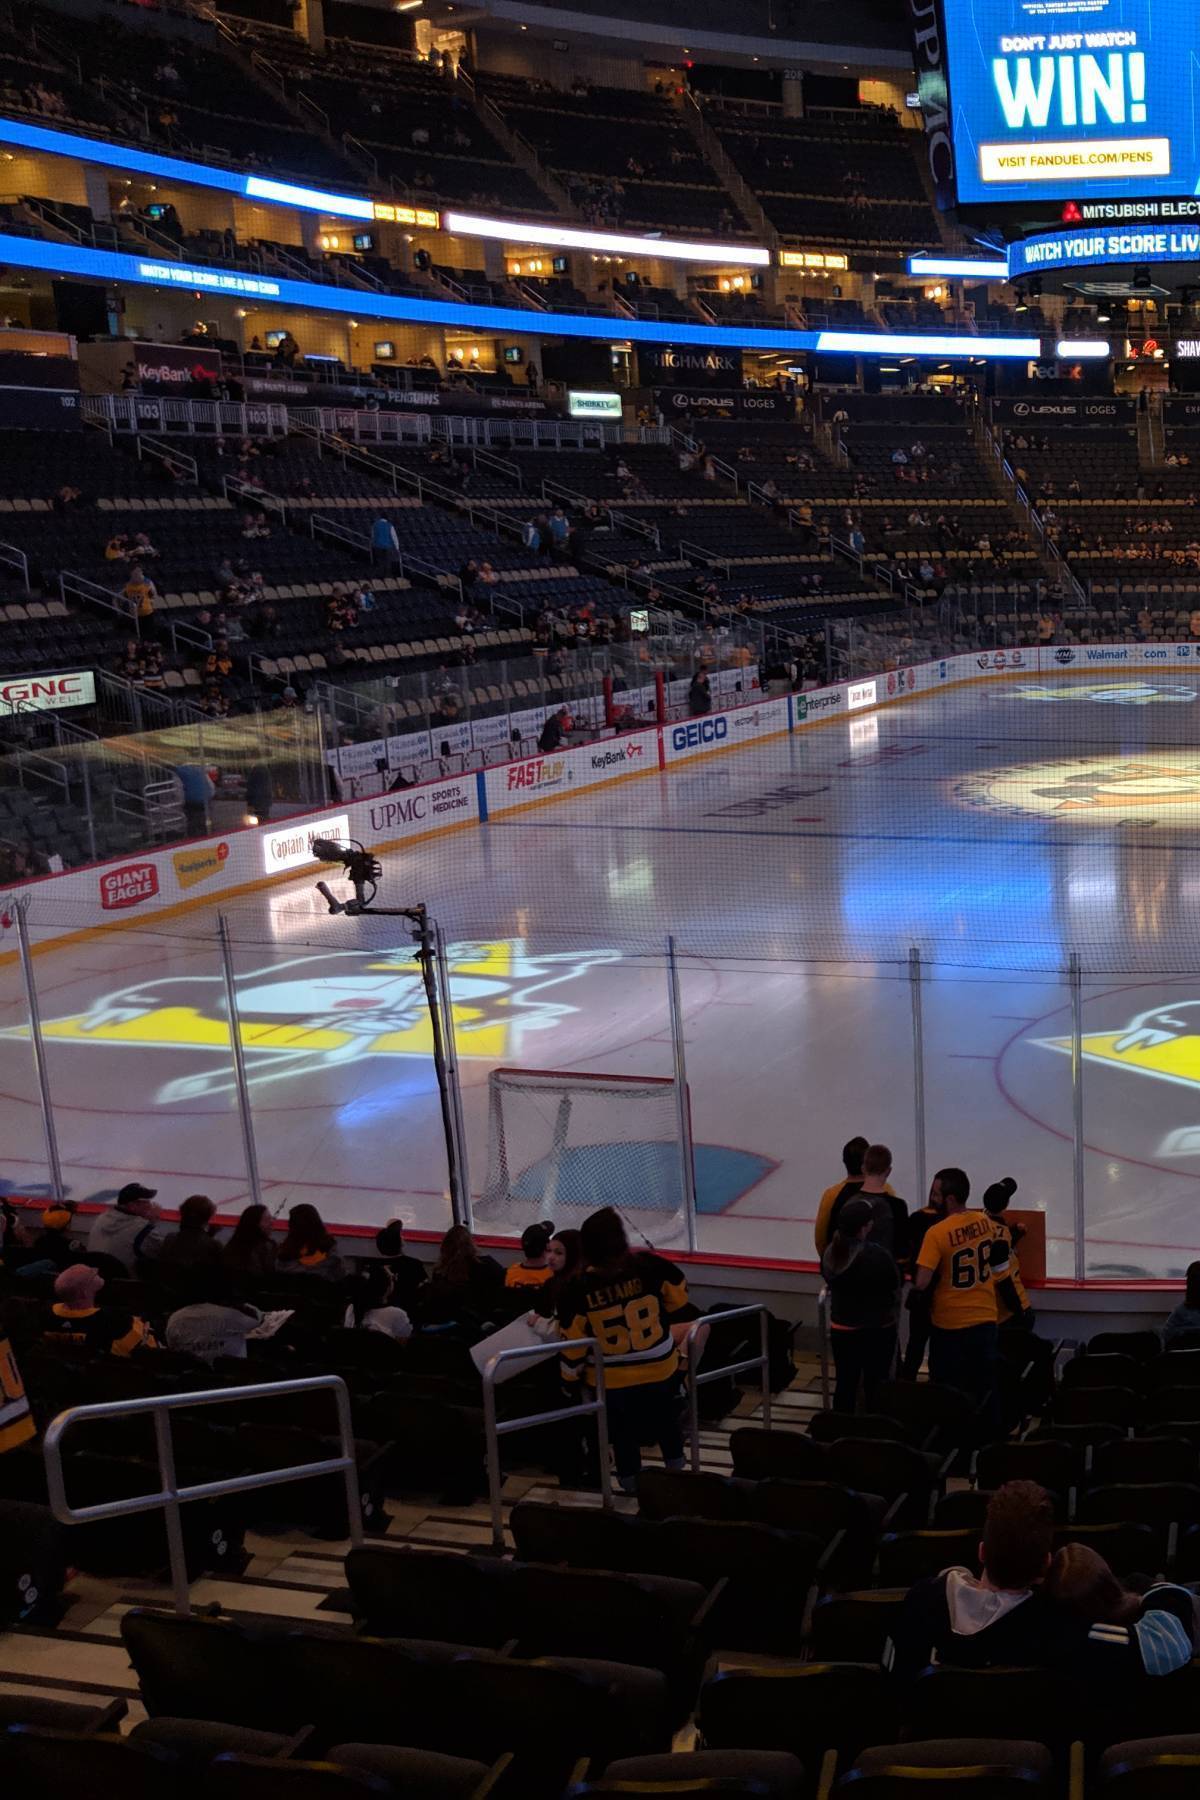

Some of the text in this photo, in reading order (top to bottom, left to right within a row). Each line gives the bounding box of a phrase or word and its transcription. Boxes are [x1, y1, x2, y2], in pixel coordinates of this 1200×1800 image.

[1001, 31, 1136, 52] DON'T JUST WATCH
[993, 52, 1147, 128] WIN!
[998, 151, 1153, 167] VISIT FANDUEL.COM/PENS
[1083, 204, 1158, 218] MITSUBISHI
[1025, 242, 1062, 263] WATCH
[1065, 237, 1105, 258] YOUR
[1109, 234, 1167, 254] SCORE
[654, 353, 735, 370] HIGHMARK
[138, 364, 192, 383] KeyBank
[388, 391, 440, 406] PENGUINS
[690, 399, 775, 409] LEXUS LOGES
[138, 404, 159, 419] 103
[250, 411, 267, 424] 103
[1031, 405, 1117, 415] LEXUS LOGES
[1087, 649, 1128, 660] Walmart
[2, 678, 82, 701] GNC
[46, 694, 84, 705] WELL
[672, 716, 727, 751] GEICO
[591, 750, 626, 769] KeyBank
[432, 786, 461, 802] SPORTS
[370, 796, 426, 831] UPMC
[432, 797, 468, 815] MEDICINE
[270, 834, 304, 861] Captain
[105, 867, 150, 889] GIANT
[108, 881, 153, 904] EAGLE
[587, 1294, 664, 1355] 58
